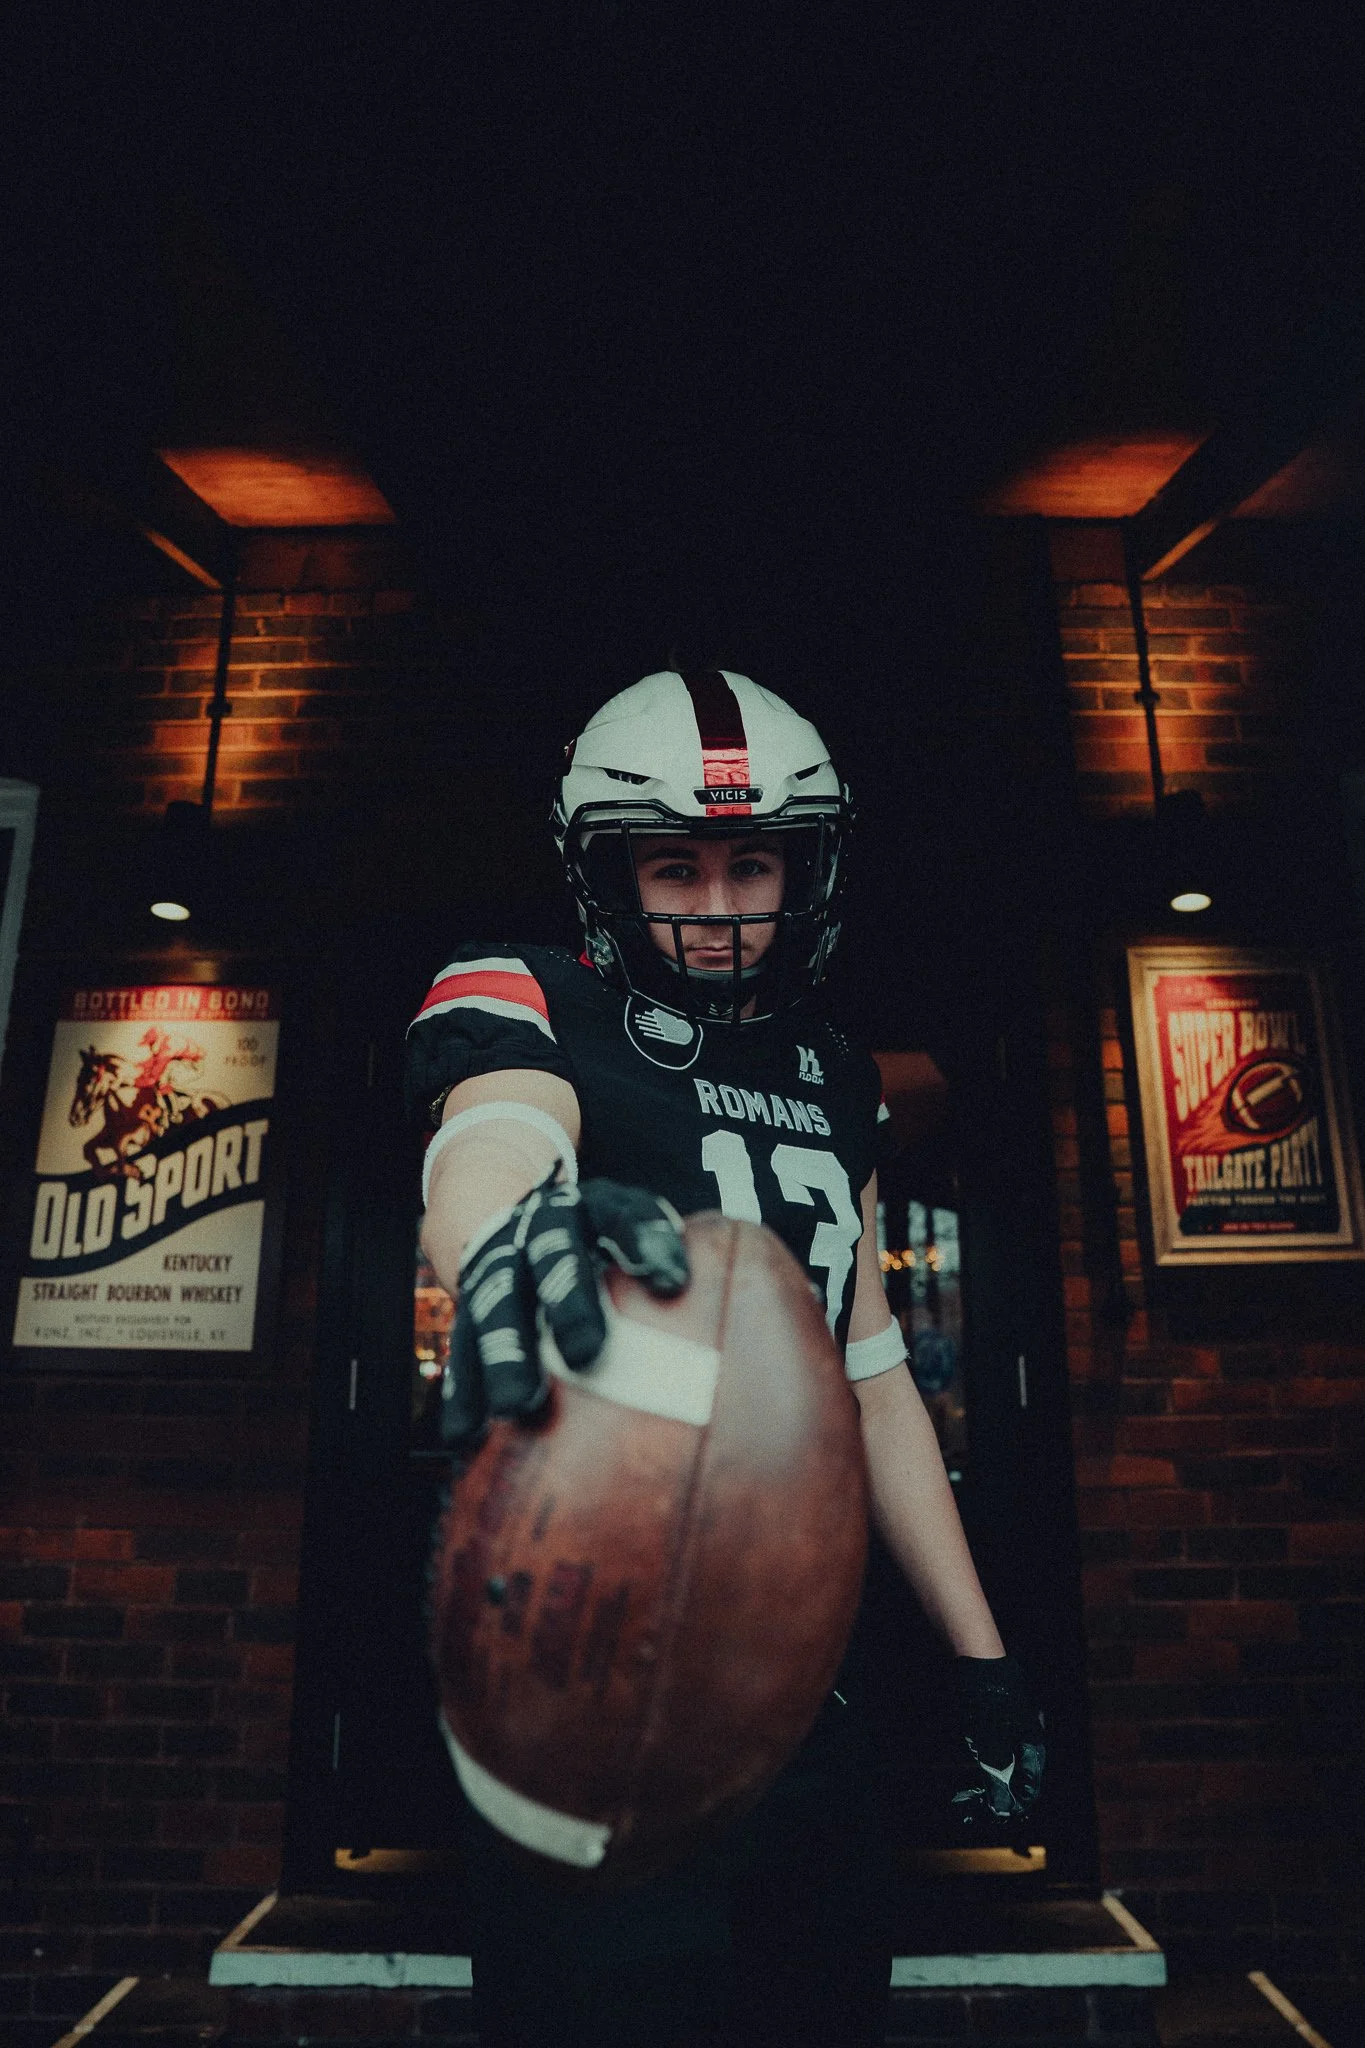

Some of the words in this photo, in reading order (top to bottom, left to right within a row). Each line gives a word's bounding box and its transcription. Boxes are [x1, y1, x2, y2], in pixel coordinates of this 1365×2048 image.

[709, 789, 748, 802] VICIS
[73, 991, 169, 1010] BOTTLED
[176, 991, 201, 1010] IN
[208, 990, 269, 1010] BOND
[1168, 1010, 1238, 1123] SUPER
[694, 1078, 831, 1136] ROMANS
[1182, 1144, 1267, 1192] TAILGATE
[1269, 1116, 1323, 1189] PARTY
[30, 1181, 117, 1260] OLD
[121, 1118, 269, 1240] SPORT
[163, 1254, 233, 1272] KENTUCKY
[33, 1283, 98, 1302] STRAIGHT
[107, 1284, 171, 1302] BOURBON
[181, 1285, 242, 1304] WHISKEY
